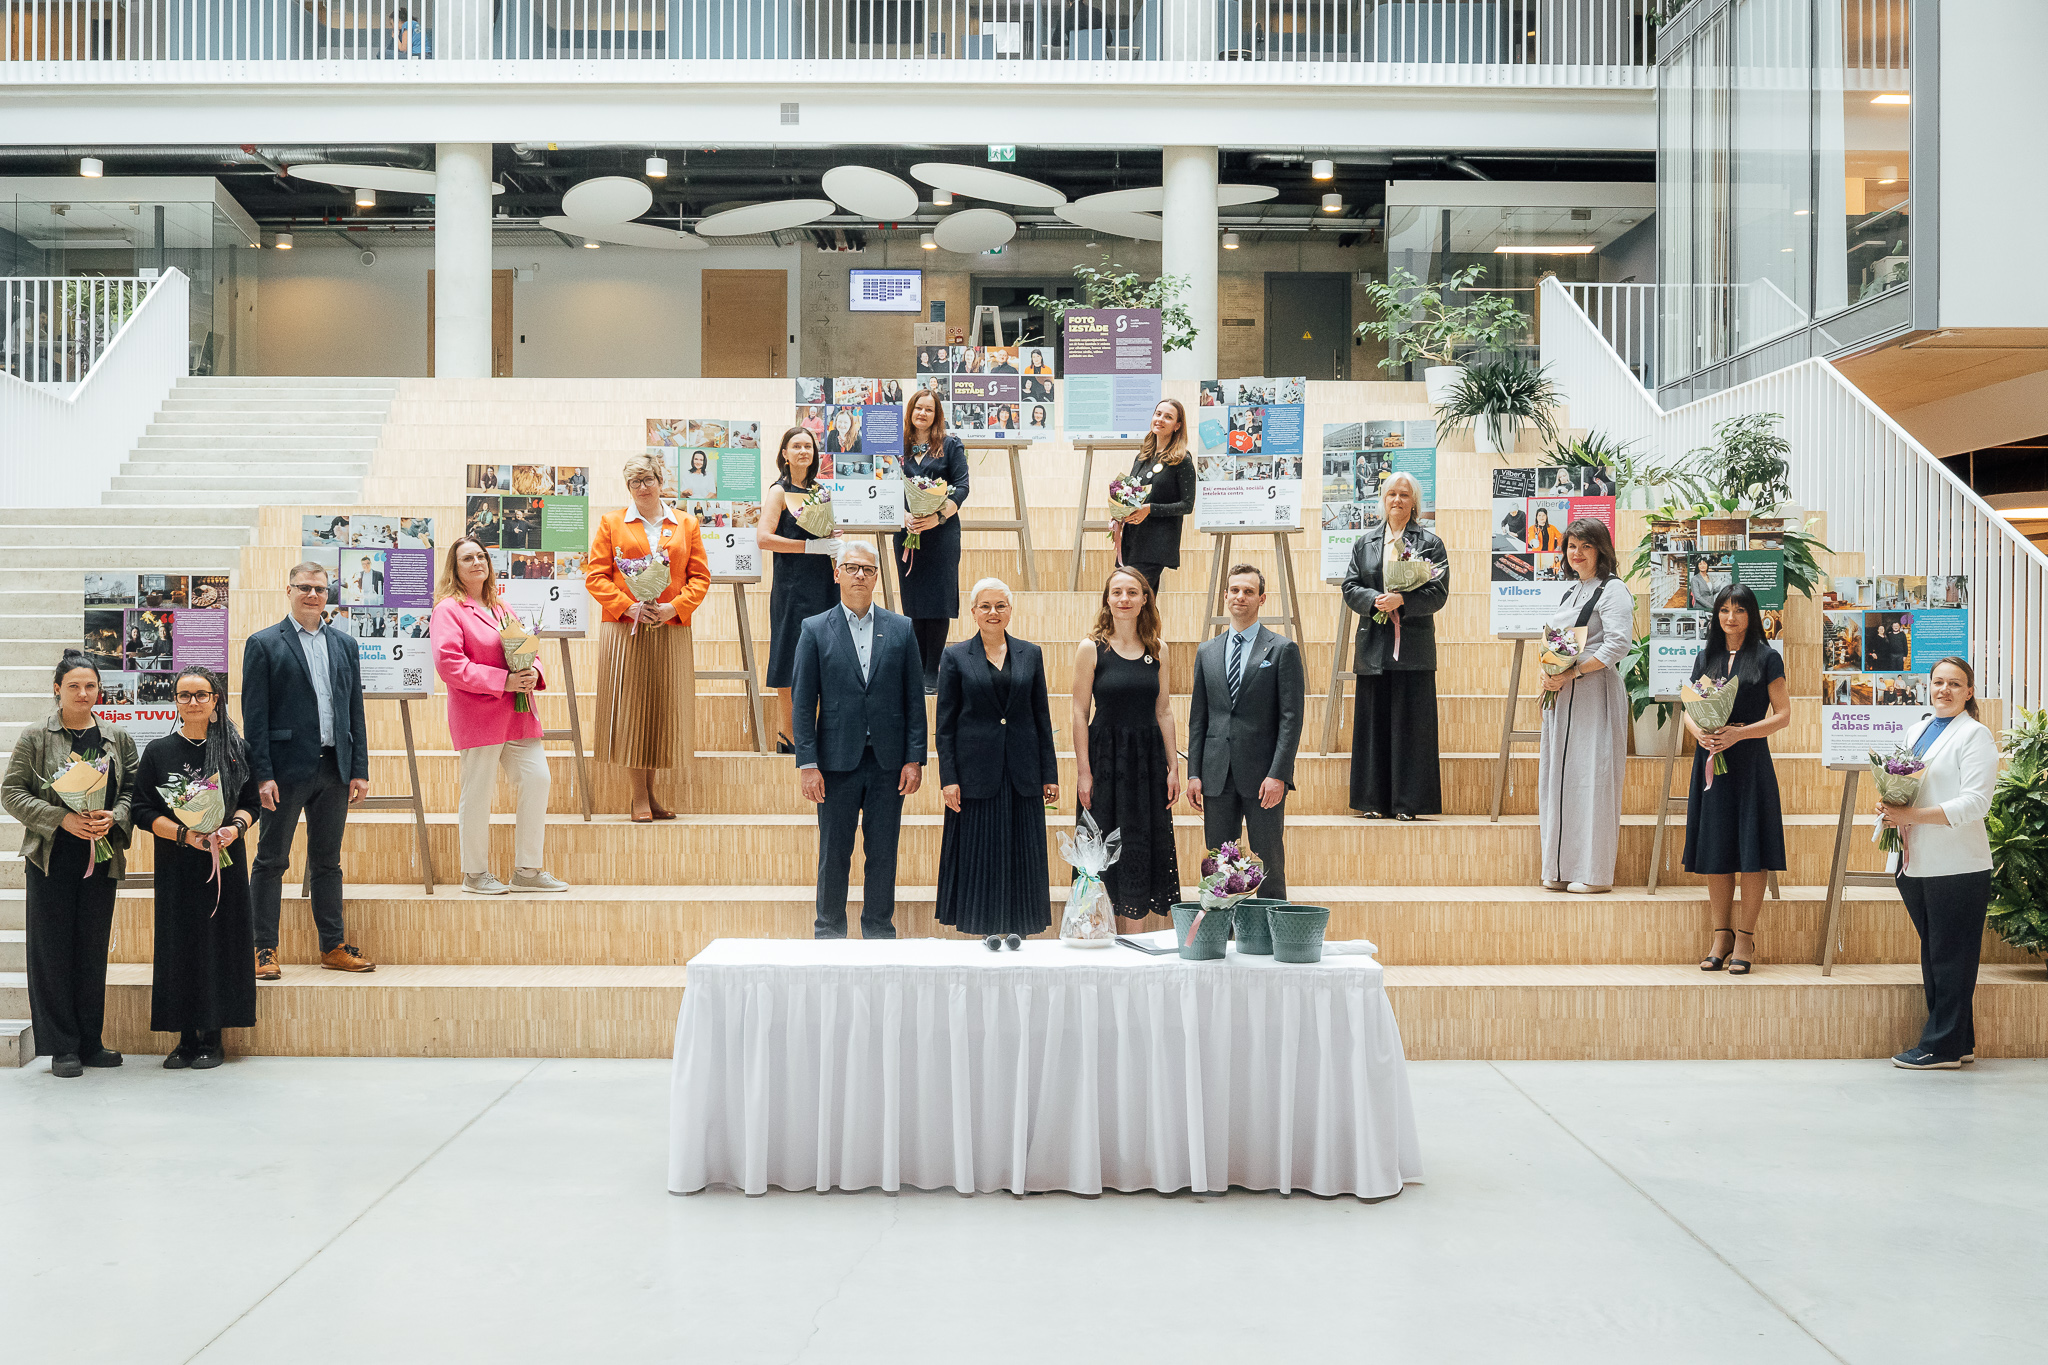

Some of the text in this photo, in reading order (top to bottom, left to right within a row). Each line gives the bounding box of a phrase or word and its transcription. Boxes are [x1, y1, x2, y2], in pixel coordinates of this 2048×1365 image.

[1068, 316, 1095, 324] FOTO
[1068, 323, 1109, 333] IZSTĀDE
[1501, 469, 1526, 478] Vilber's
[1328, 535, 1352, 544] Free
[1498, 585, 1542, 596] Vilbers
[1658, 646, 1687, 656] Otrā
[92, 709, 176, 723] Mājas TUVU
[1831, 711, 1871, 721] Ances
[1831, 720, 1904, 734] dabas māja
